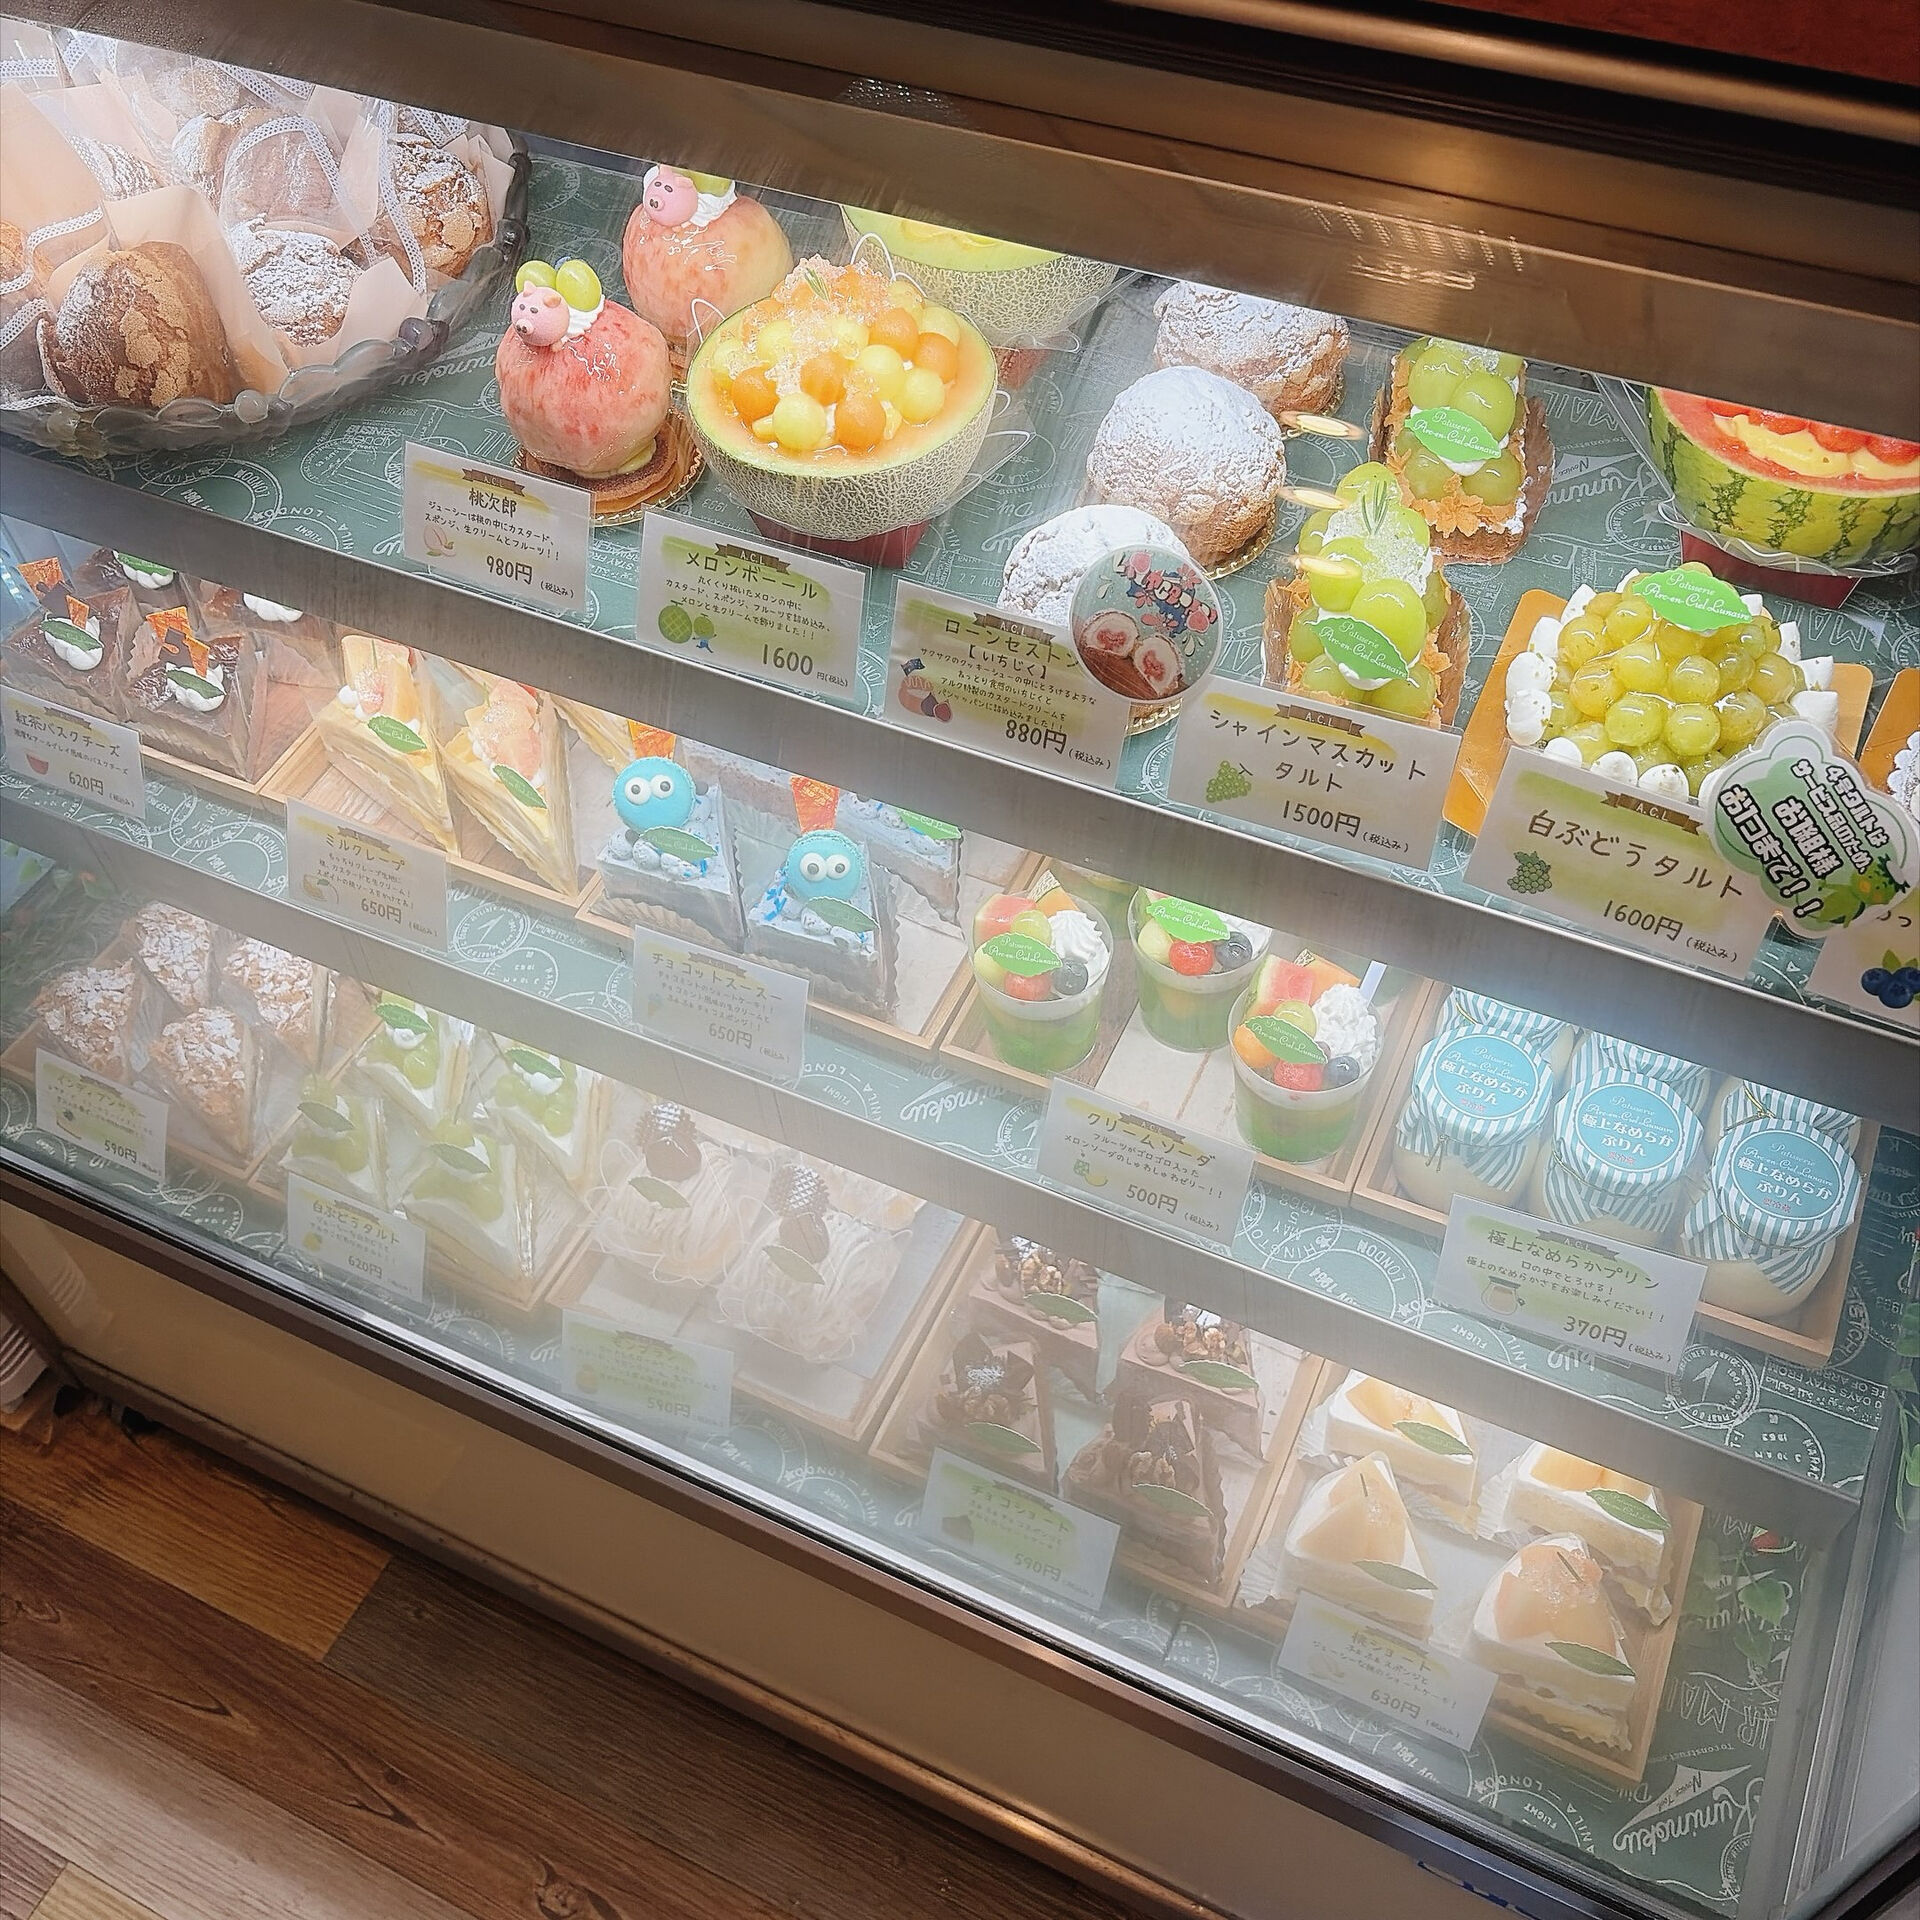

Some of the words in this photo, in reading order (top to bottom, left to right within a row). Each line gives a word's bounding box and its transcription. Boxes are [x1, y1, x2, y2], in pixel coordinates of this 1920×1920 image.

[469, 488, 517, 517] 桃次郎
[487, 556, 532, 585] 980円
[763, 644, 813, 676] 1600
[1006, 719, 1067, 755] 880円
[1210, 710, 1426, 780] シャインマスカット
[69, 771, 103, 795] 620円
[1275, 762, 1342, 792] タルト
[1284, 801, 1361, 837] 1500円
[326, 834, 405, 871] ミルクレープ
[1528, 810, 1742, 899] 白ぶどうタルト
[361, 898, 401, 924] 650円
[1604, 902, 1683, 941] 1600円
[709, 1023, 752, 1049] 650円
[1440, 1060, 1528, 1098] 極上なめらか
[1088, 1113, 1215, 1166] クリームソーダ
[1582, 1114, 1674, 1146] 極上なめらか
[1738, 1157, 1833, 1199] 極上なめらか
[1127, 1184, 1178, 1214] 500円
[348, 1256, 382, 1278] 620円
[1488, 1229, 1659, 1289] 極上なめらかプリン
[1563, 1316, 1628, 1348] 370円
[1014, 1553, 1061, 1581] 590円
[1371, 1689, 1421, 1719] 630円
